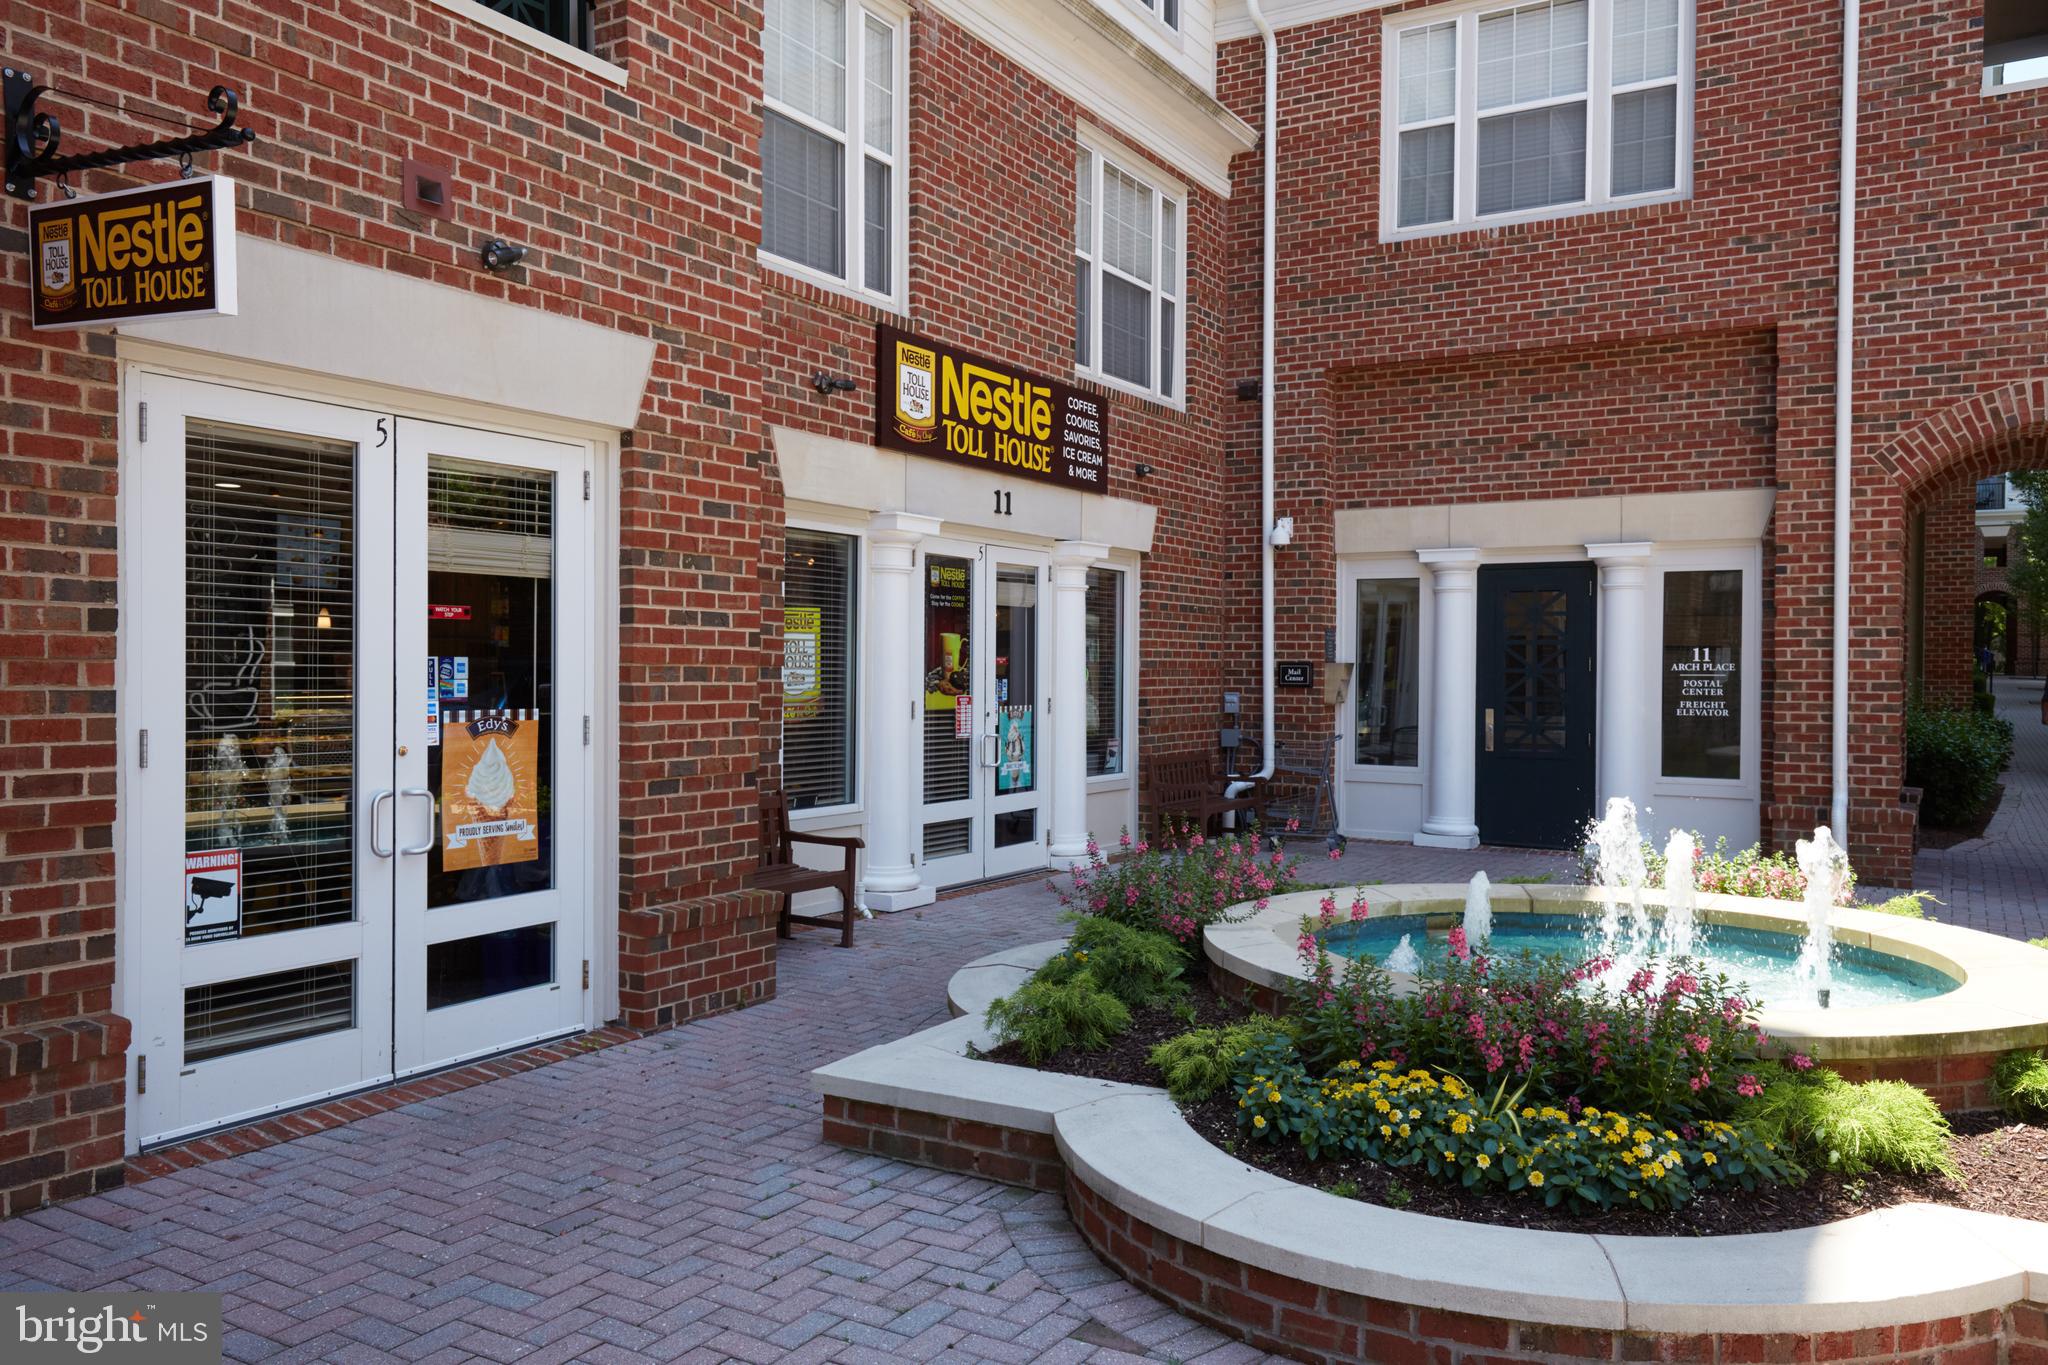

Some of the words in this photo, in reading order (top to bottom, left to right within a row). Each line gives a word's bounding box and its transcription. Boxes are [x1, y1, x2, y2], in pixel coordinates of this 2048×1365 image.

[78, 195, 204, 274] Nestlé
[48, 246, 65, 259] TOLL
[45, 258, 69, 271] HOUSE
[81, 276, 128, 309] TOLL
[134, 267, 206, 304] HOUSE
[901, 347, 931, 369] Nestlé
[907, 371, 926, 388] TOLL
[902, 382, 930, 401] HOUSE
[942, 355, 1052, 441] Nestlé
[1067, 396, 1099, 418] COFFEE,
[1065, 413, 1101, 435] COOKIES,
[376, 418, 387, 448] 5
[1063, 429, 1102, 452] SAVORIES,
[942, 419, 988, 459] TOLL
[994, 433, 1052, 473] HOUSE
[1062, 446, 1076, 460] ICE
[1076, 449, 1103, 467] CREAM
[1068, 465, 1074, 477] &
[1075, 467, 1097, 482] MORE
[994, 490, 1012, 515] 11
[978, 545, 984, 562] 5
[784, 655, 814, 669] OUSE
[1692, 647, 1711, 662] 11
[1671, 663, 1700, 671] ARCH
[1703, 663, 1736, 671] PLACE
[1682, 688, 1724, 696] CENTER
[1676, 708, 1729, 716] ELEVATOR
[1680, 701, 1726, 709] FREIGHT
[477, 716, 508, 732] Edy's
[459, 826, 481, 837] PROUDLY
[482, 823, 504, 834] SERVING
[186, 853, 238, 870] WARNING!
